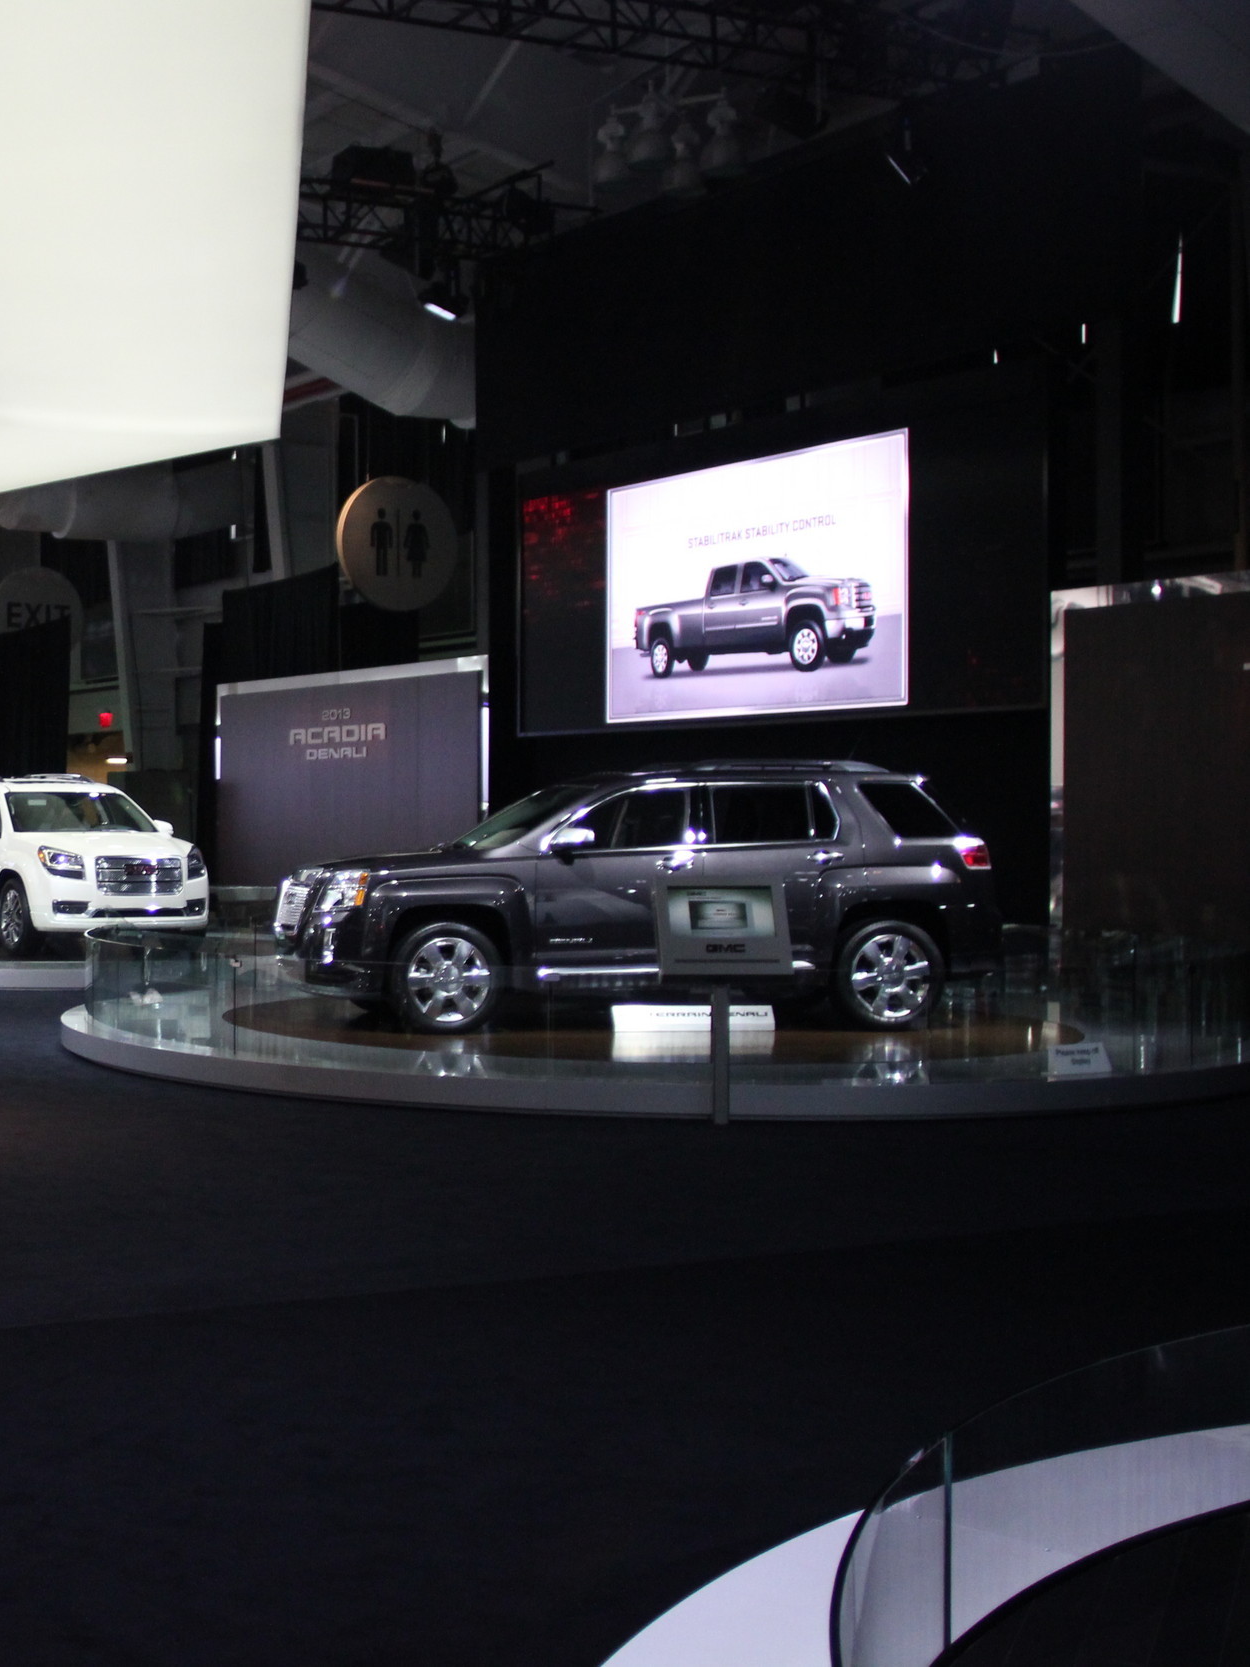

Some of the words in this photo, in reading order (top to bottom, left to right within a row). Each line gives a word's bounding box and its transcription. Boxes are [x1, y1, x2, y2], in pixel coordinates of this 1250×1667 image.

[688, 530, 743, 549] STABILITRAK
[745, 521, 790, 540] STABILITY
[792, 514, 837, 532] CONTROL
[322, 708, 351, 720] 2013
[290, 722, 387, 746] ACADIA
[305, 746, 368, 760] DENALI
[706, 943, 746, 953] GMC
